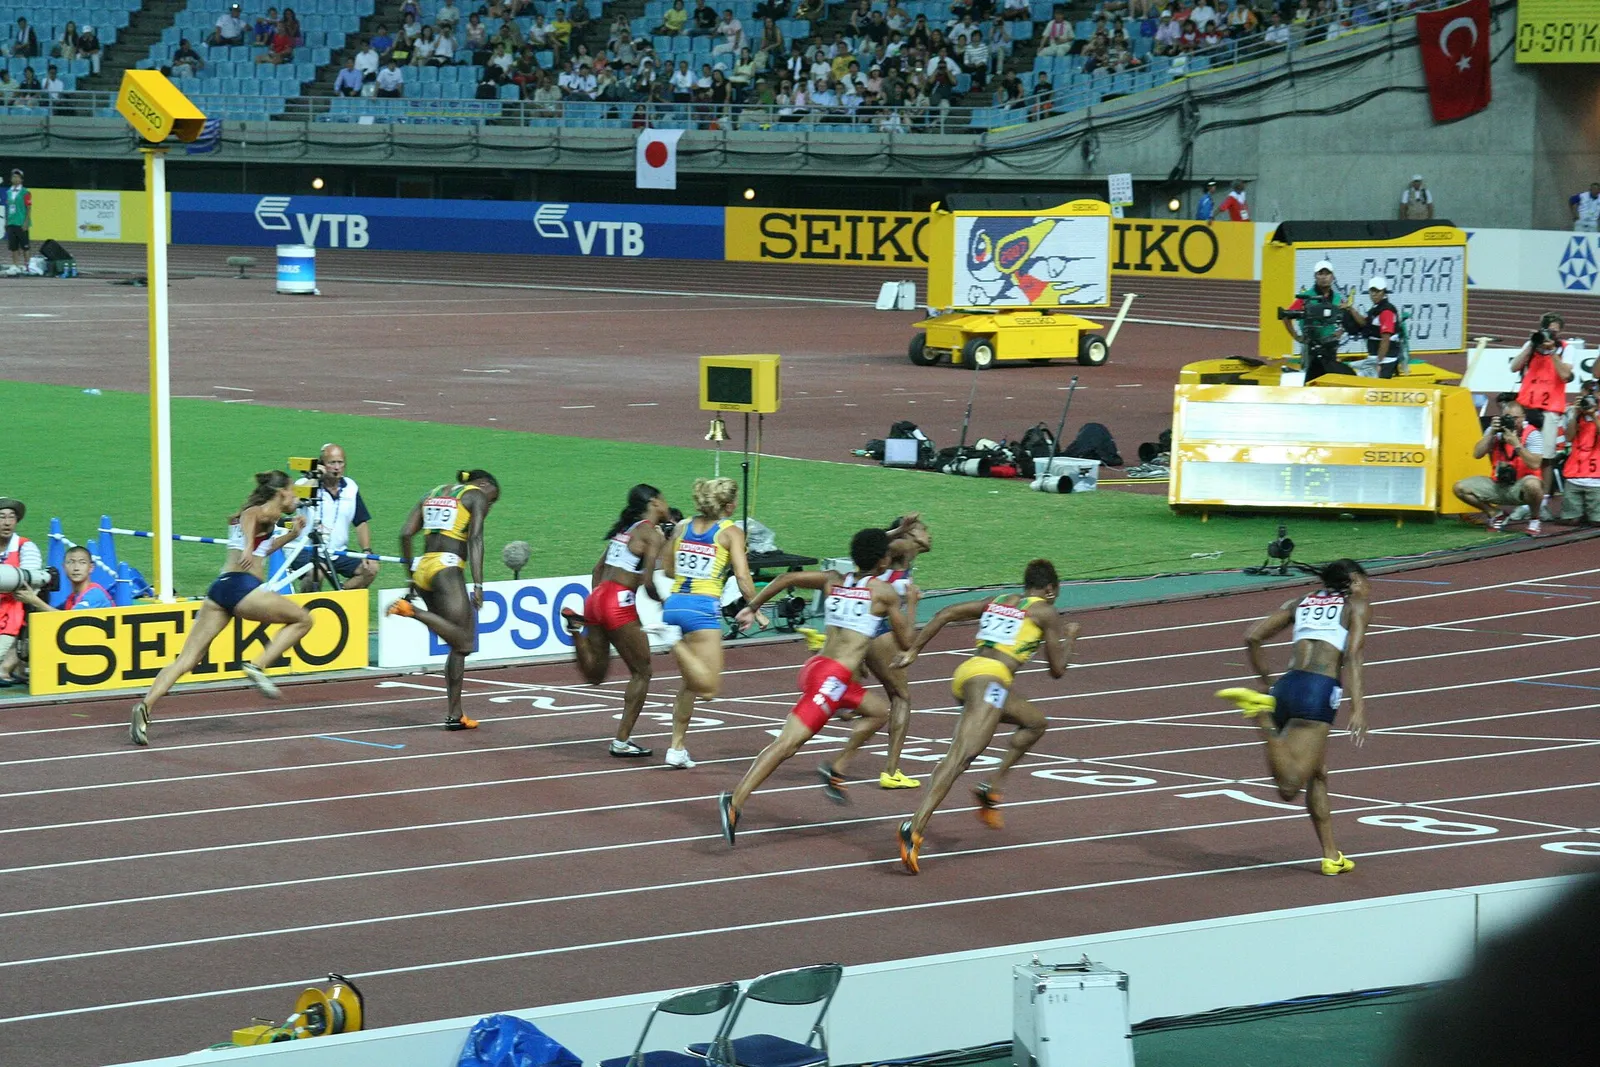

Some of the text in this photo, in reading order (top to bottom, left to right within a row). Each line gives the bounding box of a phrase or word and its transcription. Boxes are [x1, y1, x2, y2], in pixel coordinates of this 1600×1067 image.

[127, 90, 162, 129] SEIKO
[1072, 203, 1099, 212] SEIKO
[296, 213, 369, 248] VTB
[573, 221, 644, 256] VTB
[1424, 231, 1454, 240] SEIKO
[1112, 223, 1219, 274] IKO
[1014, 317, 1057, 325] SEIKO
[1365, 390, 1428, 404] SEIKO
[1363, 450, 1426, 464] SEIKO
[678, 552, 711, 571] 887
[429, 582, 590, 656] PSO
[489, 696, 609, 711] 2
[1030, 768, 1158, 787] 6
[1174, 789, 1309, 810] 7
[1357, 814, 1500, 836] 8
